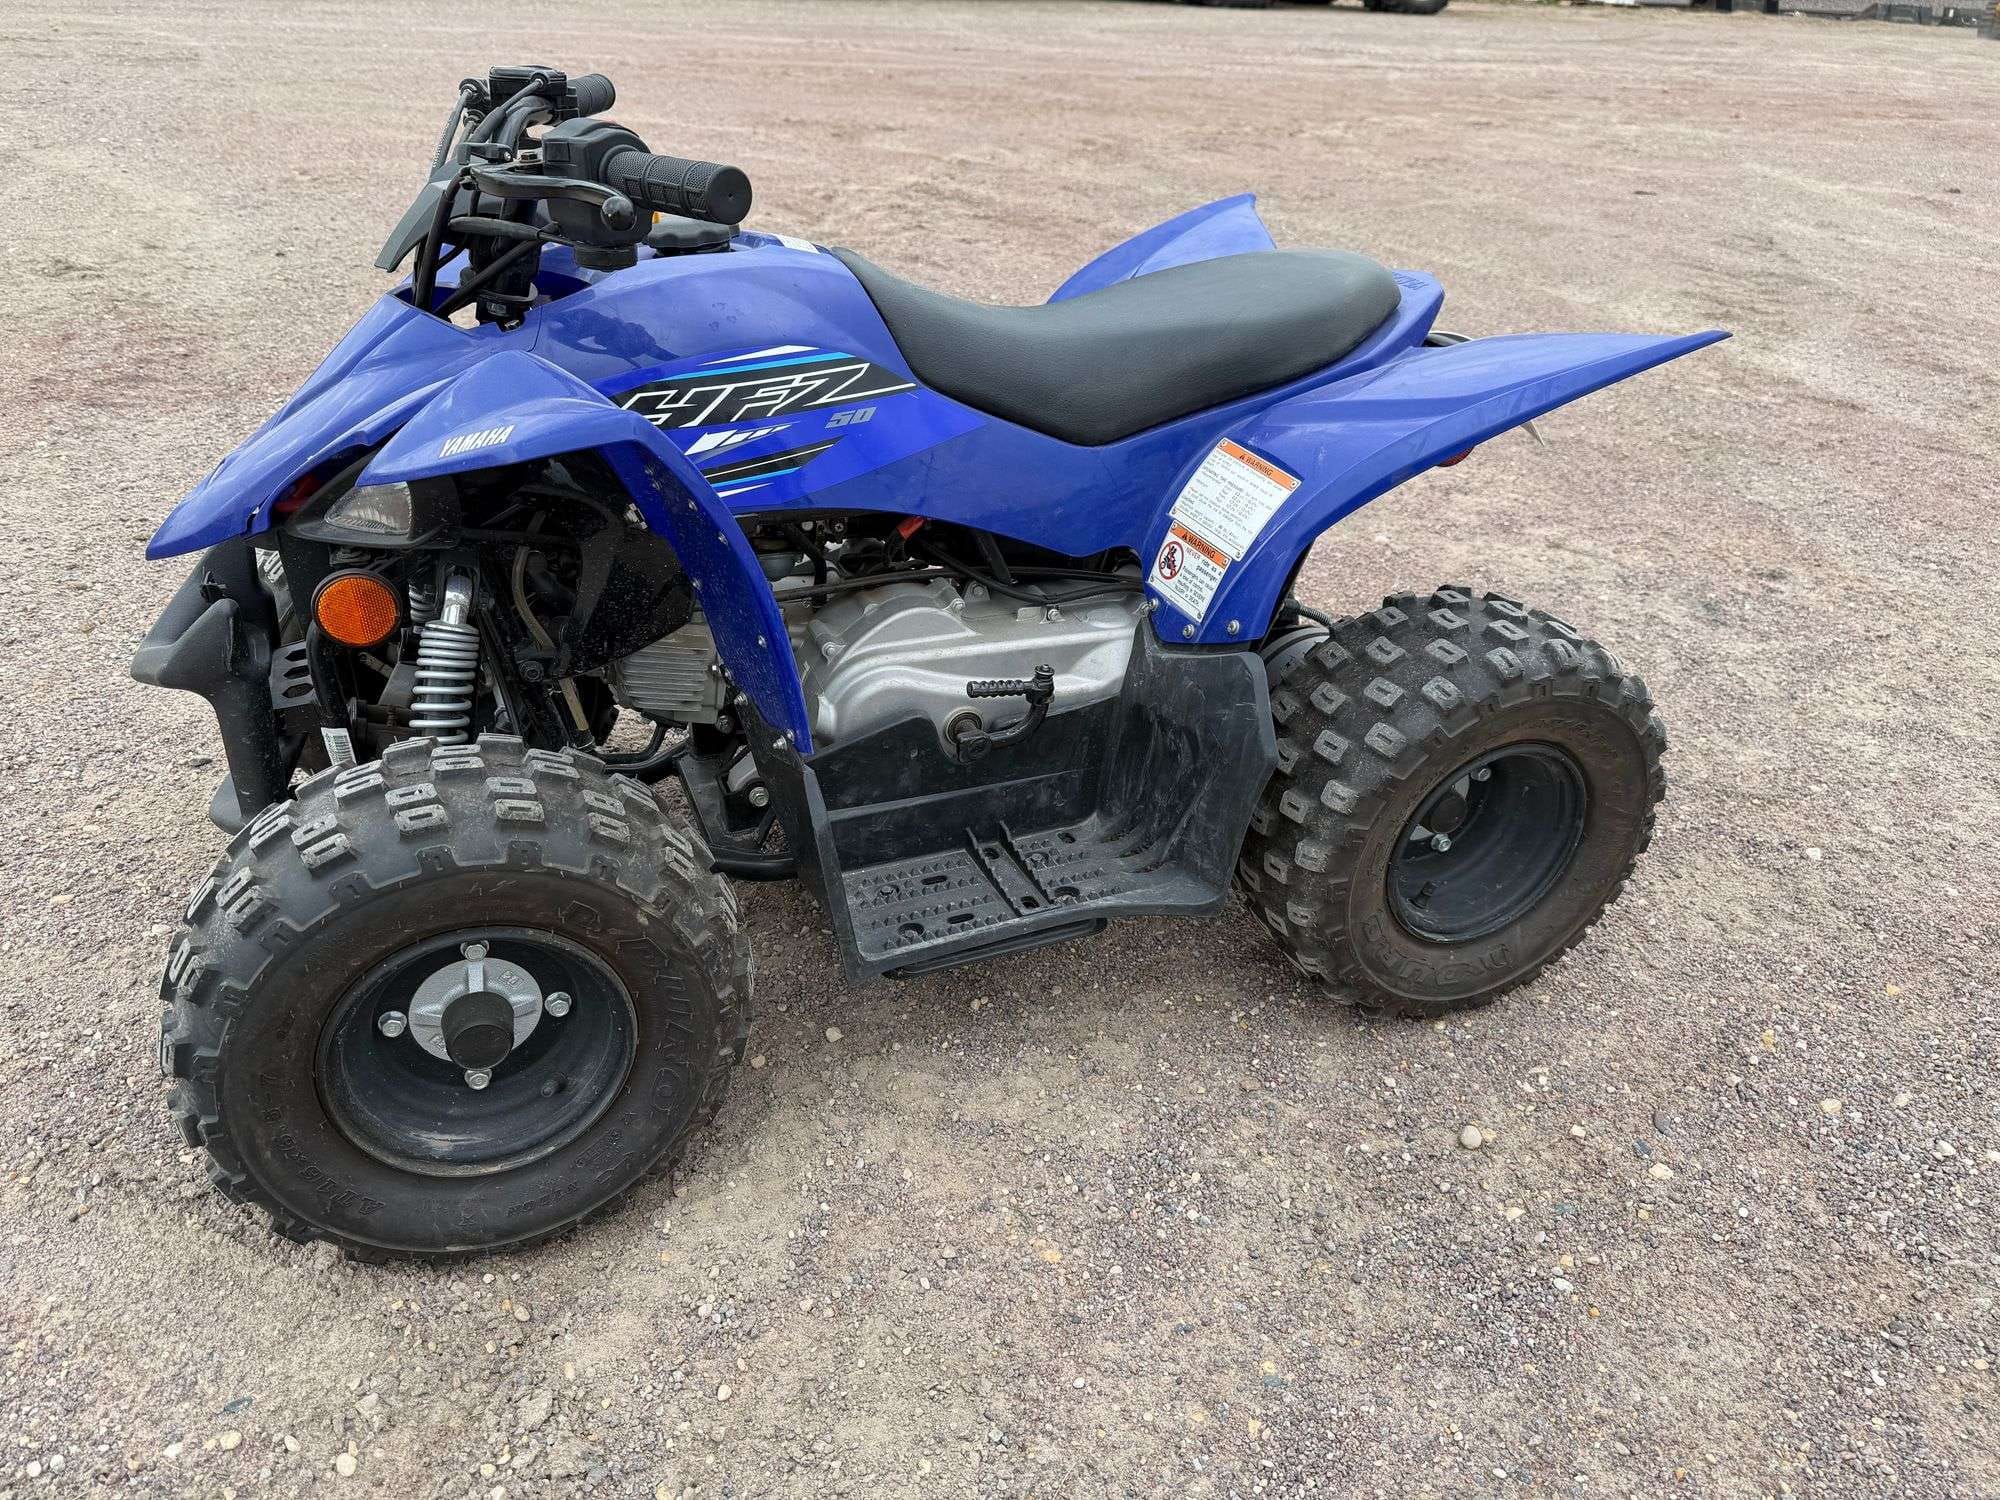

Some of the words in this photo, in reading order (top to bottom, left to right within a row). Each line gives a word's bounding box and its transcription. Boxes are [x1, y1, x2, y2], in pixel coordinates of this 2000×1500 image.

[825, 406, 878, 429] 50
[437, 424, 516, 460] YAMAHA
[1245, 456, 1273, 476] WARNING
[1188, 534, 1216, 559] WARNING
